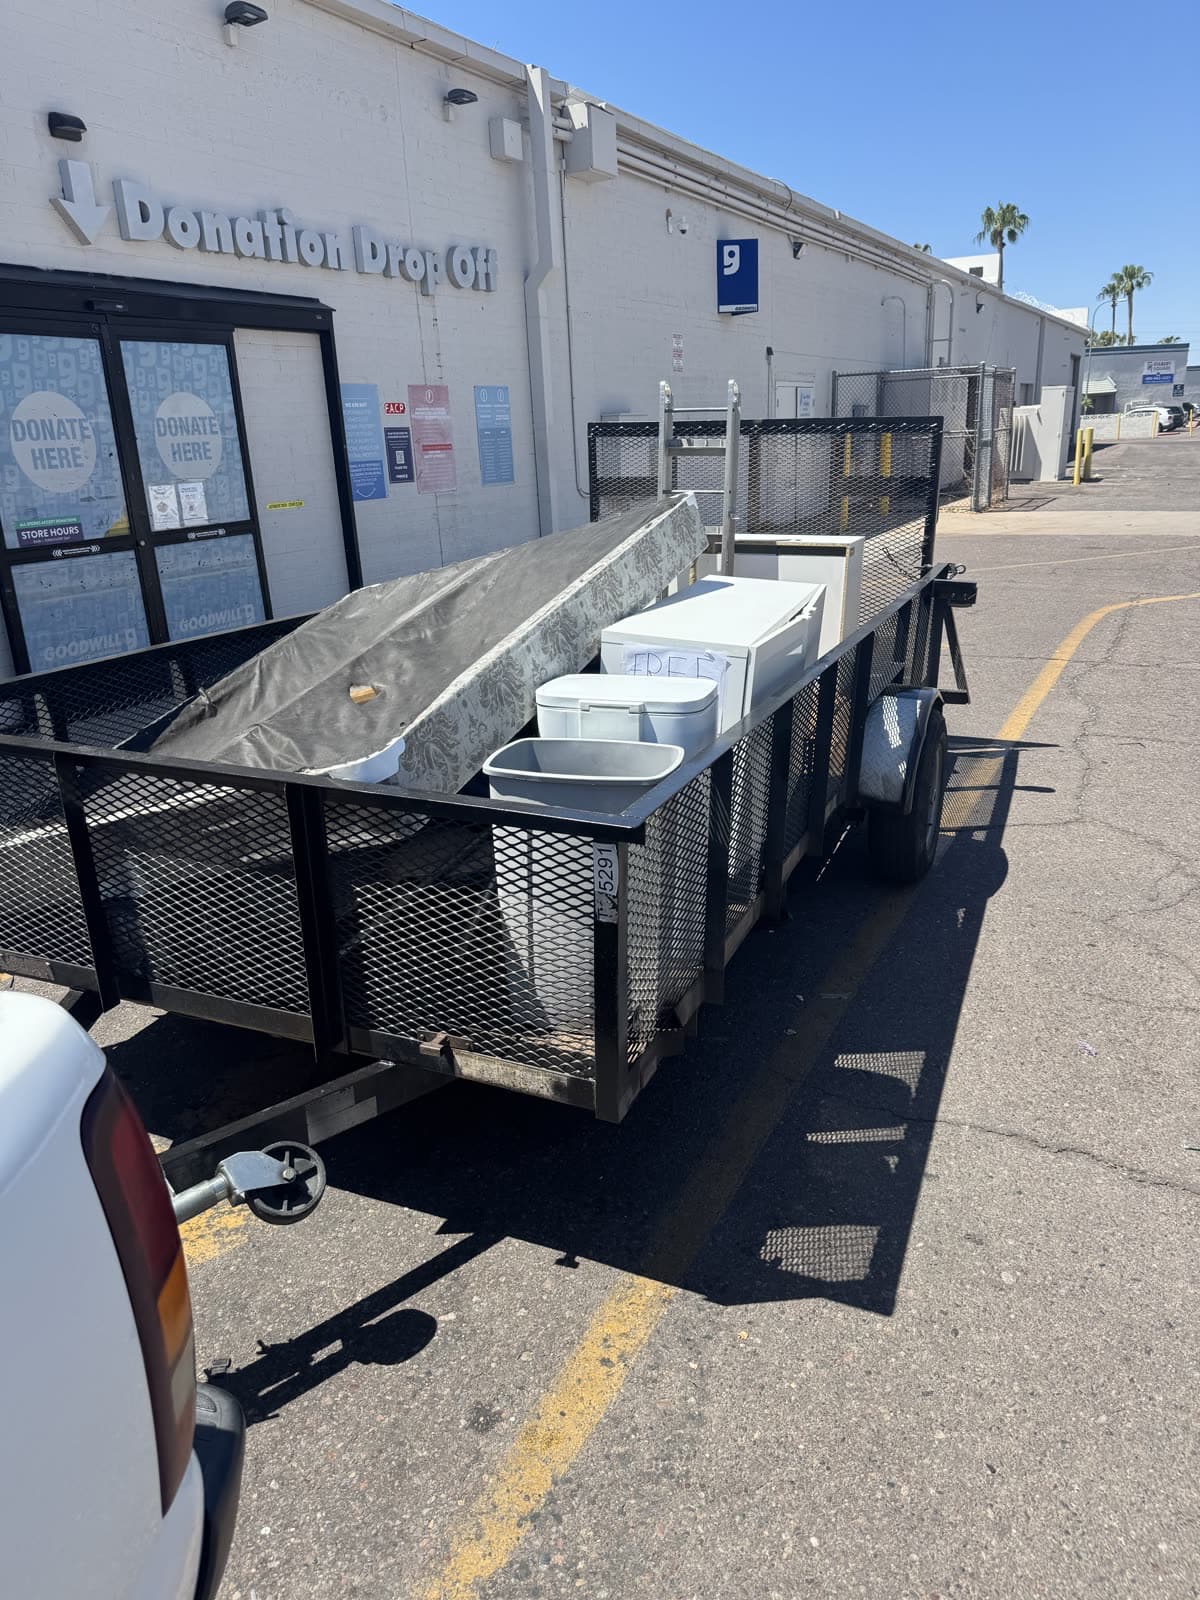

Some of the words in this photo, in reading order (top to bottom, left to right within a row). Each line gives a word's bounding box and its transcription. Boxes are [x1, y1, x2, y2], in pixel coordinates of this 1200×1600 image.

[113, 178, 350, 271] Donation
[352, 225, 440, 296] Drop
[446, 246, 497, 292] Off
[385, 403, 404, 413] FACP
[12, 418, 92, 442] DONATE
[156, 416, 219, 437] DONATE
[31, 447, 84, 470] HERE
[171, 441, 212, 462] HERE
[21, 529, 48, 539] STORE
[50, 527, 79, 536] HOURS
[179, 608, 242, 632] GOODWILL
[44, 633, 122, 662] GOODWILL
[630, 652, 717, 680] FREE
